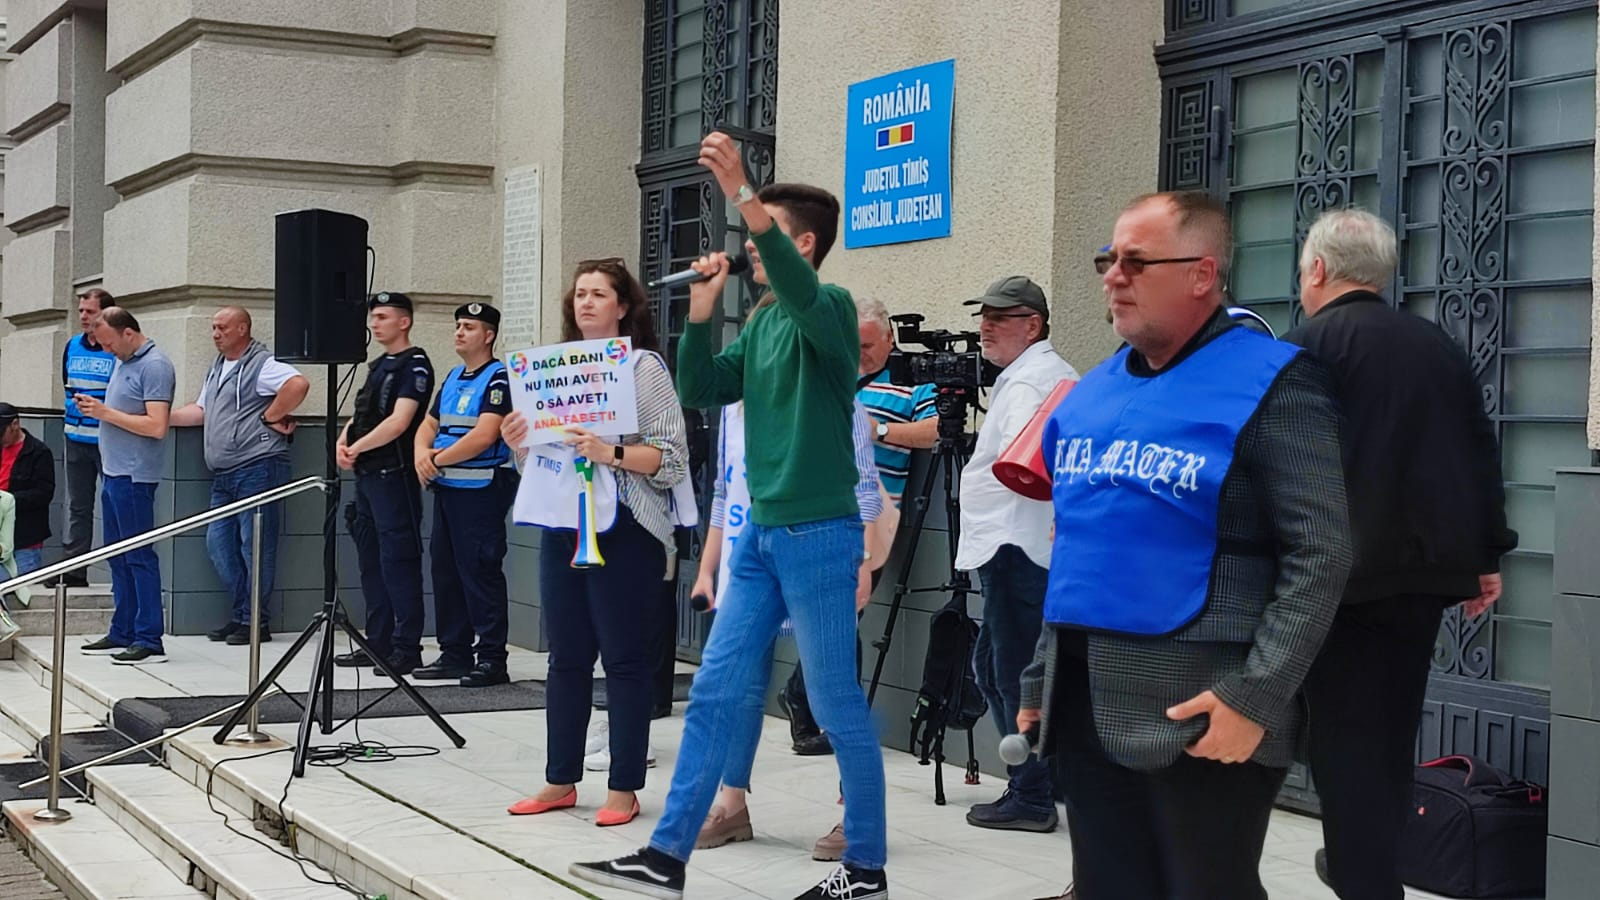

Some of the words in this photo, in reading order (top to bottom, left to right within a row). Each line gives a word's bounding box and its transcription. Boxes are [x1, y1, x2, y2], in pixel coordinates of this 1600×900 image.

[569, 352, 604, 366] BANI
[525, 380, 541, 392] NU
[545, 376, 568, 389] MAI
[536, 400, 545, 410] O
[1089, 439, 1206, 499] MATER
